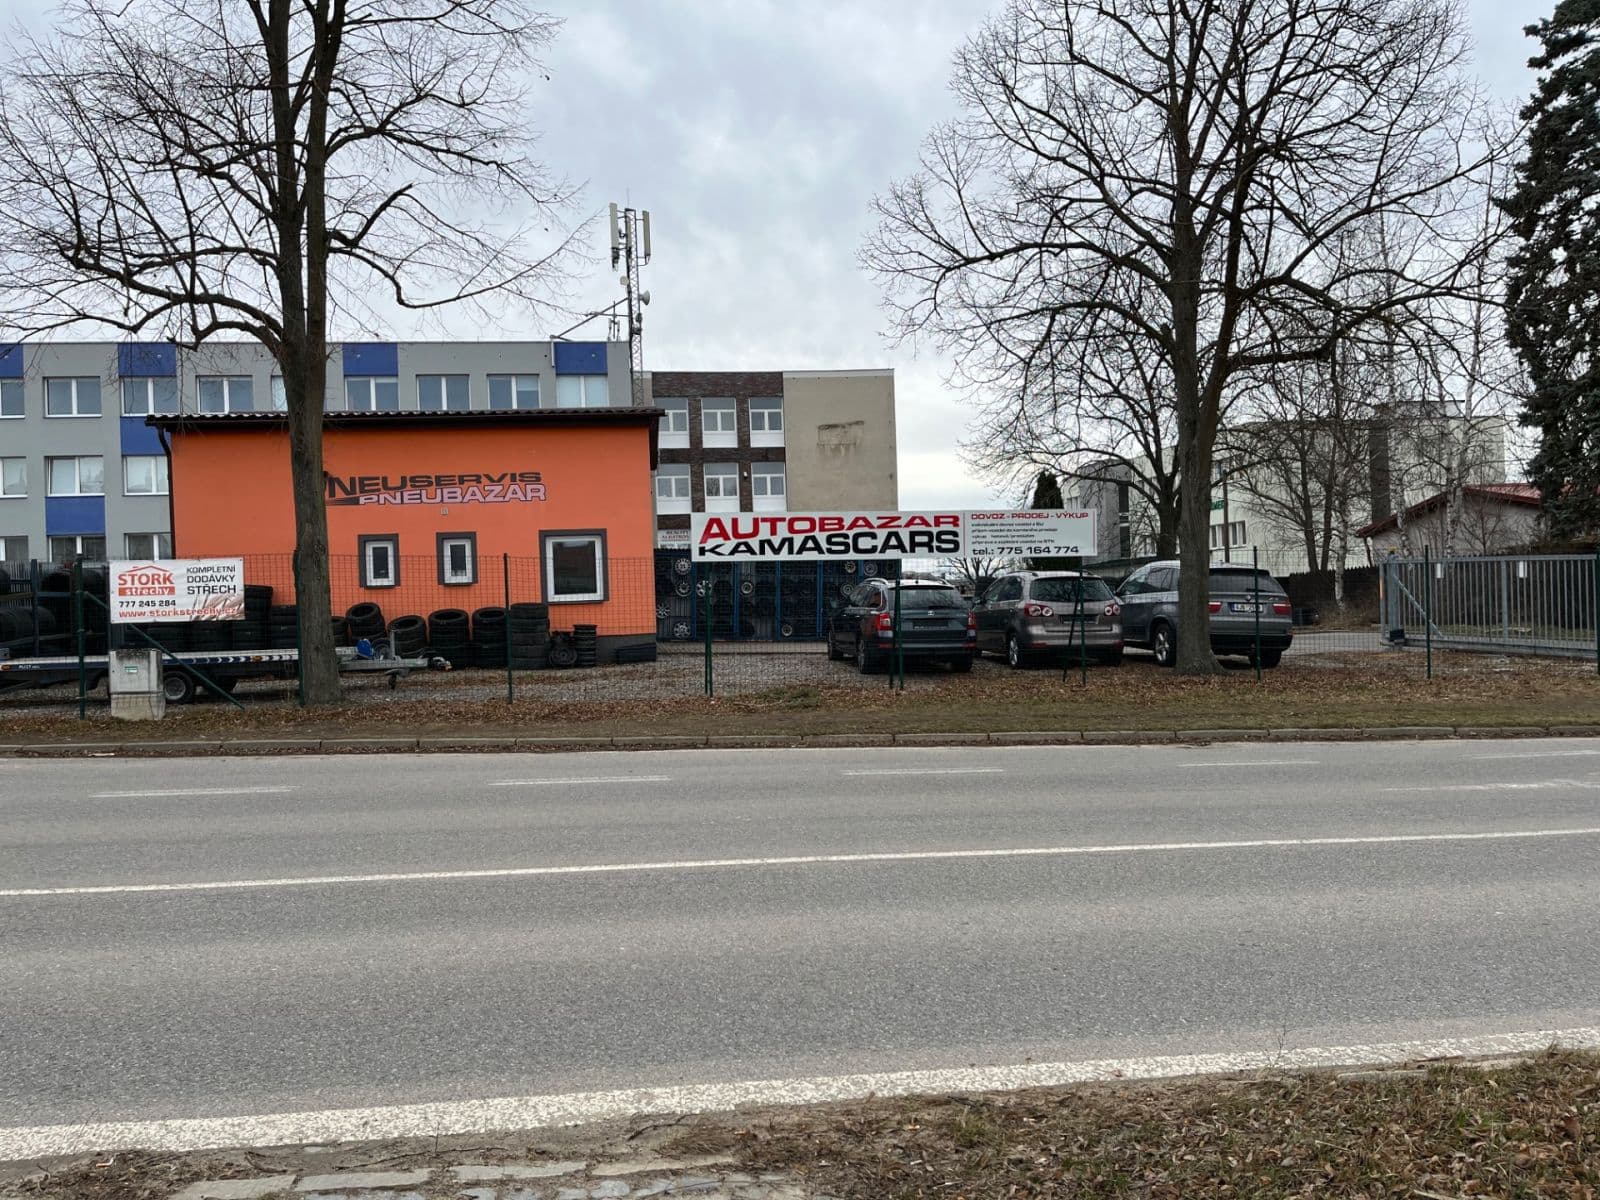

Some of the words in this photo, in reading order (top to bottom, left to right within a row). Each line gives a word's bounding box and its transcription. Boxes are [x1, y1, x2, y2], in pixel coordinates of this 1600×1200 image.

[323, 471, 542, 498] NEUSERVIS
[358, 484, 546, 505] PNEUBAZAR
[1055, 511, 1089, 519] VÝKUP
[699, 515, 960, 544] AUTOBAZAR
[698, 530, 960, 556] KAMASCARS
[972, 547, 994, 556] tel.:
[997, 546, 1023, 555] 775
[1026, 546, 1051, 554] 164
[1054, 546, 1079, 554] 774
[186, 565, 236, 574] KOMPLETNÍ
[118, 573, 174, 586] STORK
[186, 574, 236, 584] DODÁVKY
[125, 586, 170, 596] střechy
[187, 583, 237, 595] STŘECH
